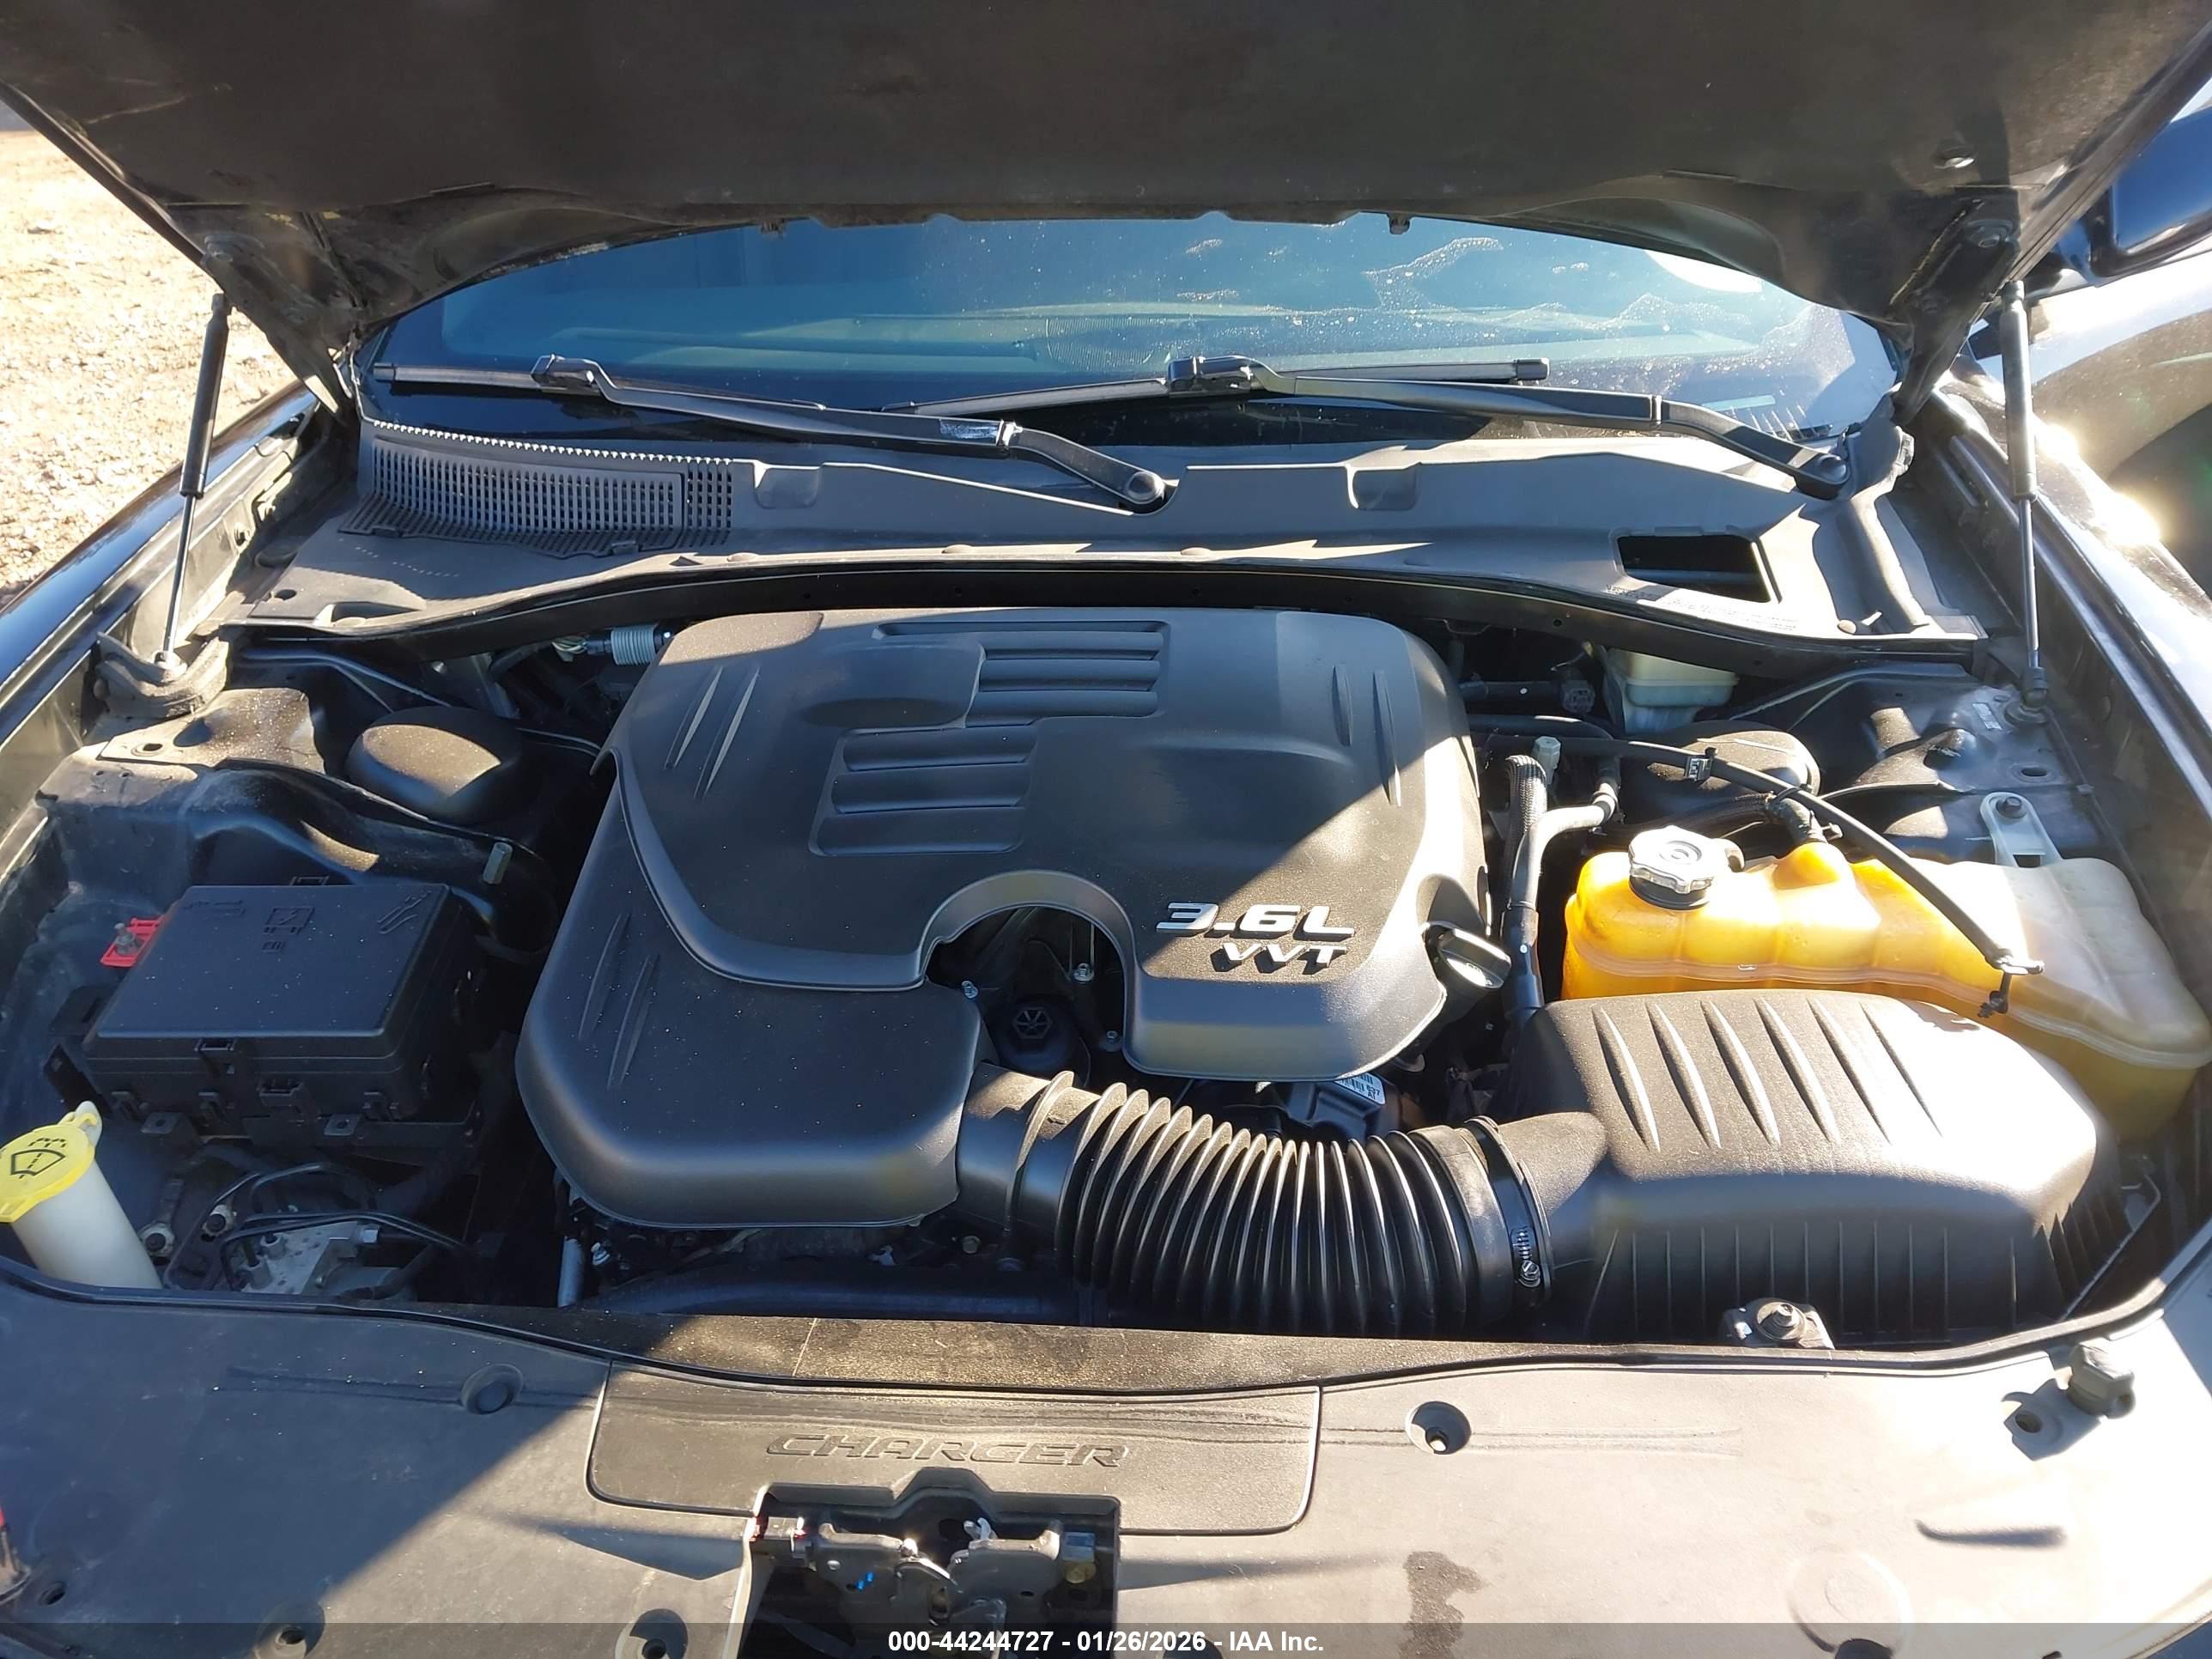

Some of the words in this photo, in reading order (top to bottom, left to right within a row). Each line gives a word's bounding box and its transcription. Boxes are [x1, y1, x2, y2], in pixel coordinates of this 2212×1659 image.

[1156, 902, 1355, 936] 3.6L
[1221, 944, 1347, 967] VVT
[767, 1433, 1127, 1468] CHARGER
